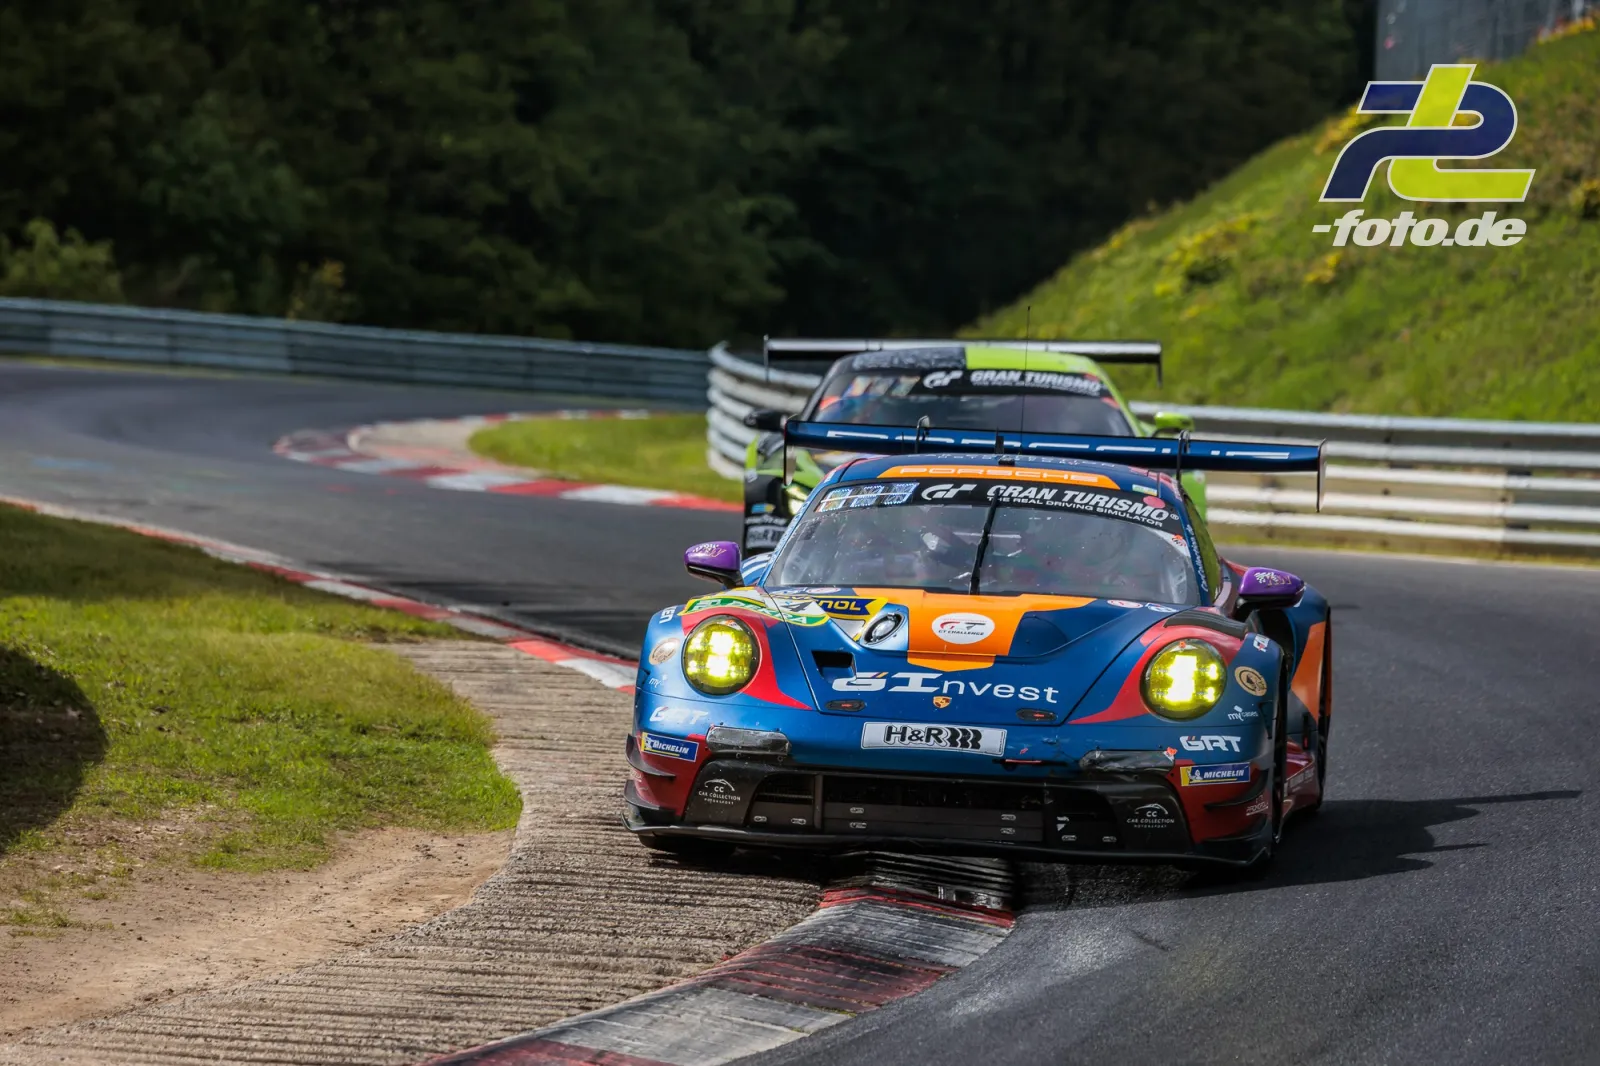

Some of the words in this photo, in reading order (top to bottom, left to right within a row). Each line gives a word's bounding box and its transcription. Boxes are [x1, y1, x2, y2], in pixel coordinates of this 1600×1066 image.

[970, 370, 1020, 383] GRAN
[1025, 371, 1101, 392] TURISMO
[900, 467, 1098, 483] PORSCHE
[986, 484, 1058, 500] GRAN
[1045, 500, 1094, 511] DRIVING
[1096, 508, 1163, 527] SIMULATOR
[885, 725, 946, 745] H&R
[652, 740, 690, 754] MICHELIN
[1180, 735, 1241, 752] GRT
[1203, 769, 1245, 779] MICHELIN
[709, 793, 741, 801] COLLECTION
